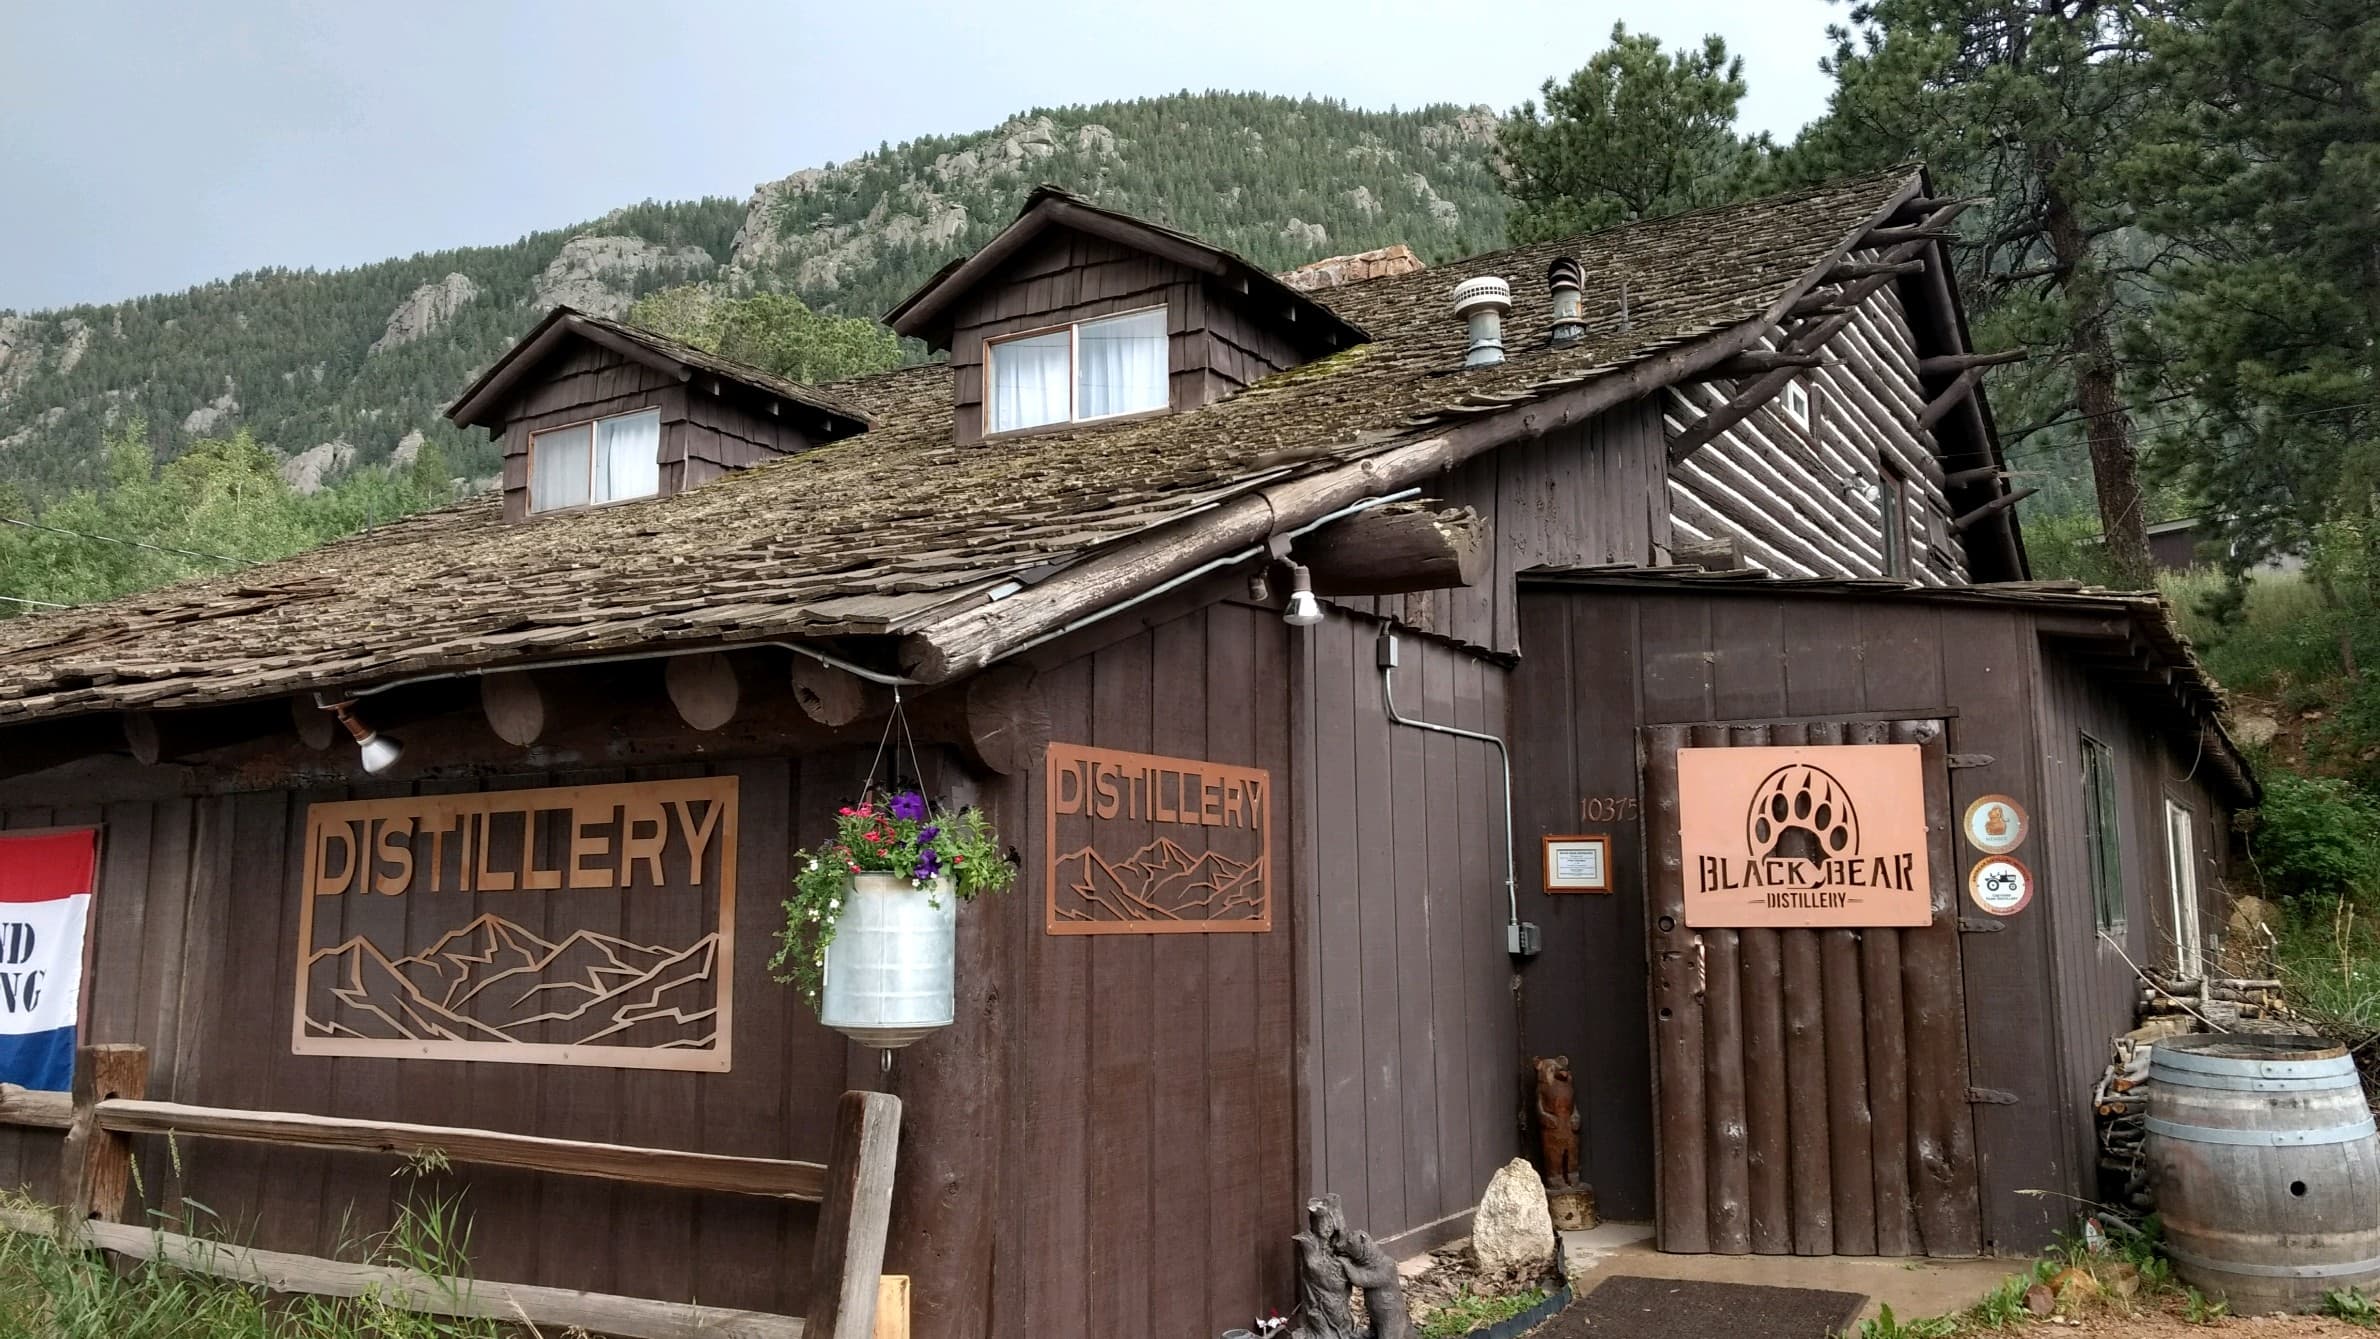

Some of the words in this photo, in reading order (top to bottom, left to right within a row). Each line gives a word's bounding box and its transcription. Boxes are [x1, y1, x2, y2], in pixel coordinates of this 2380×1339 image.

[1055, 759, 1263, 830] DISTILLERY
[1579, 796, 1638, 822] 10375
[316, 799, 726, 897] DISTILLERY
[1698, 854, 1807, 893] BLACK
[1826, 852, 1914, 891] BEAR
[1766, 892, 1847, 909] DISTILLERY
